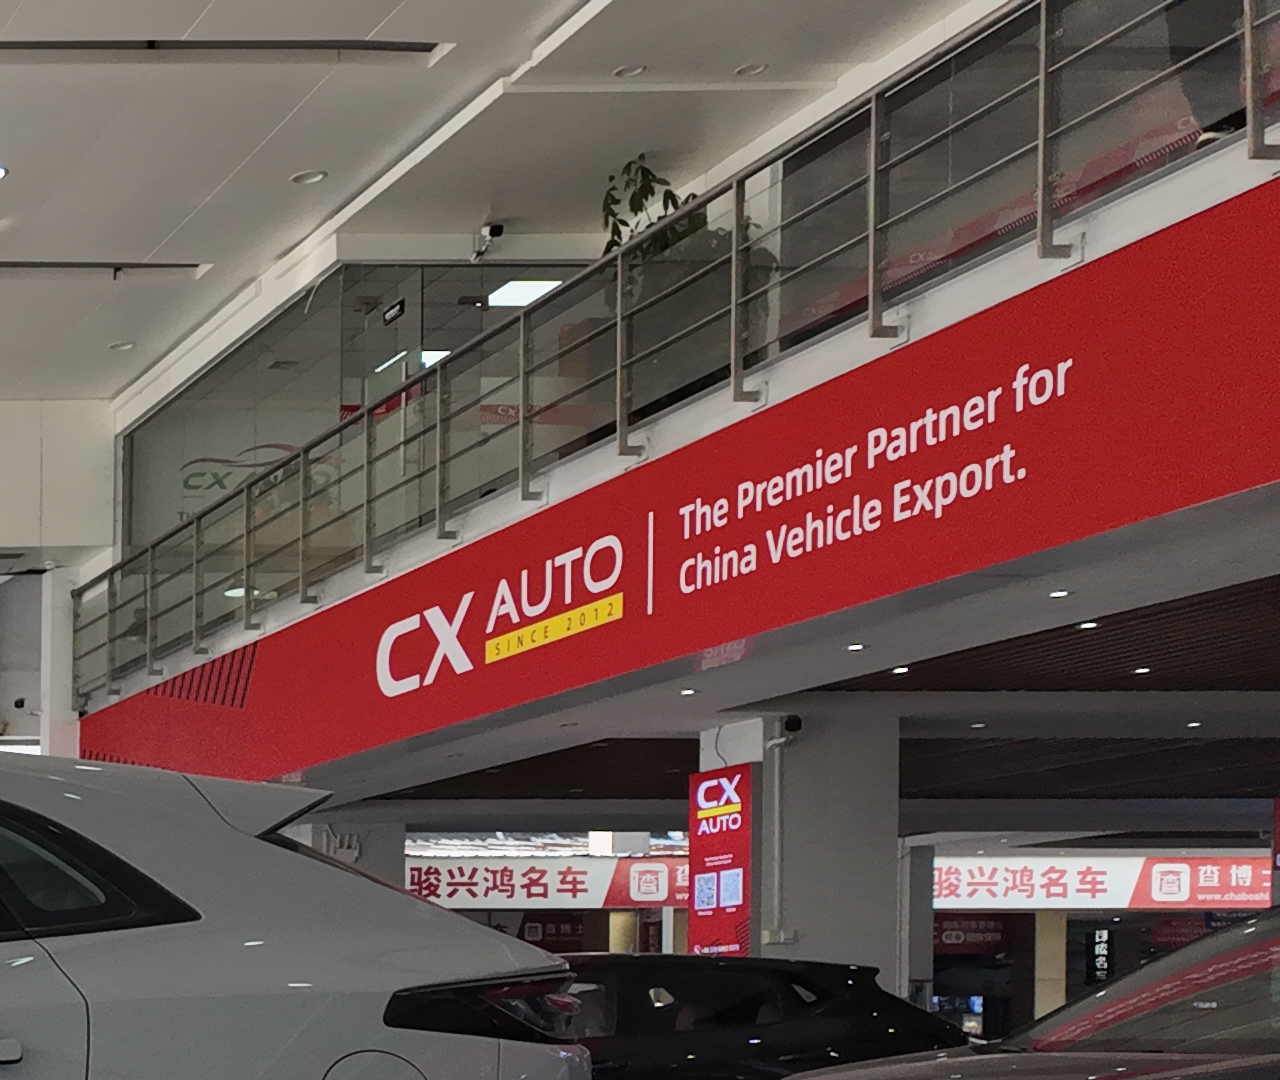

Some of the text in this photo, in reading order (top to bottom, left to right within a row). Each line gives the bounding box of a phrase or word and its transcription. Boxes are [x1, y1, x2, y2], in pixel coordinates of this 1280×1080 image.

[679, 358, 1073, 540] The Premier Partner for
[679, 443, 1027, 594] China Vehicle Export.
[376, 534, 623, 697] CX AUTO
[495, 602, 614, 656] SINCE 2012
[697, 774, 741, 809] CX
[697, 814, 741, 836] AUTO
[410, 865, 589, 899] 骏兴鸿名车
[933, 866, 1108, 899] 骏兴鸿名车
